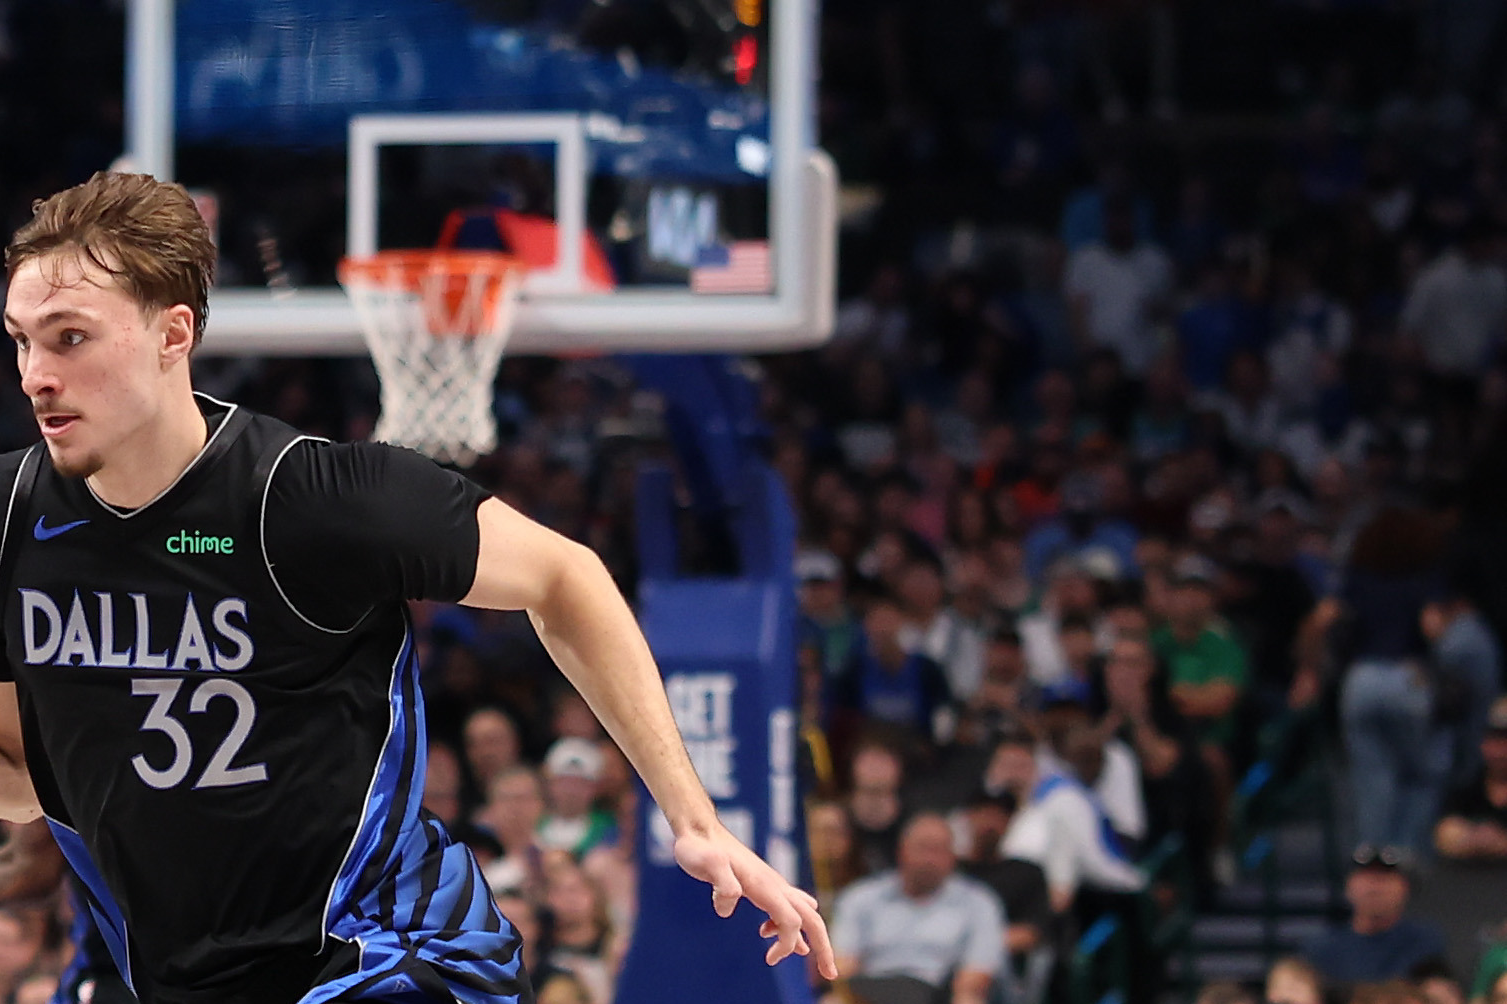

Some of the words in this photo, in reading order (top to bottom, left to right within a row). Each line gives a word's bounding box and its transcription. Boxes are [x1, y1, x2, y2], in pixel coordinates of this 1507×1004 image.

[165, 529, 234, 554] chime
[18, 587, 255, 672] DALLAS
[130, 677, 270, 791] 32
